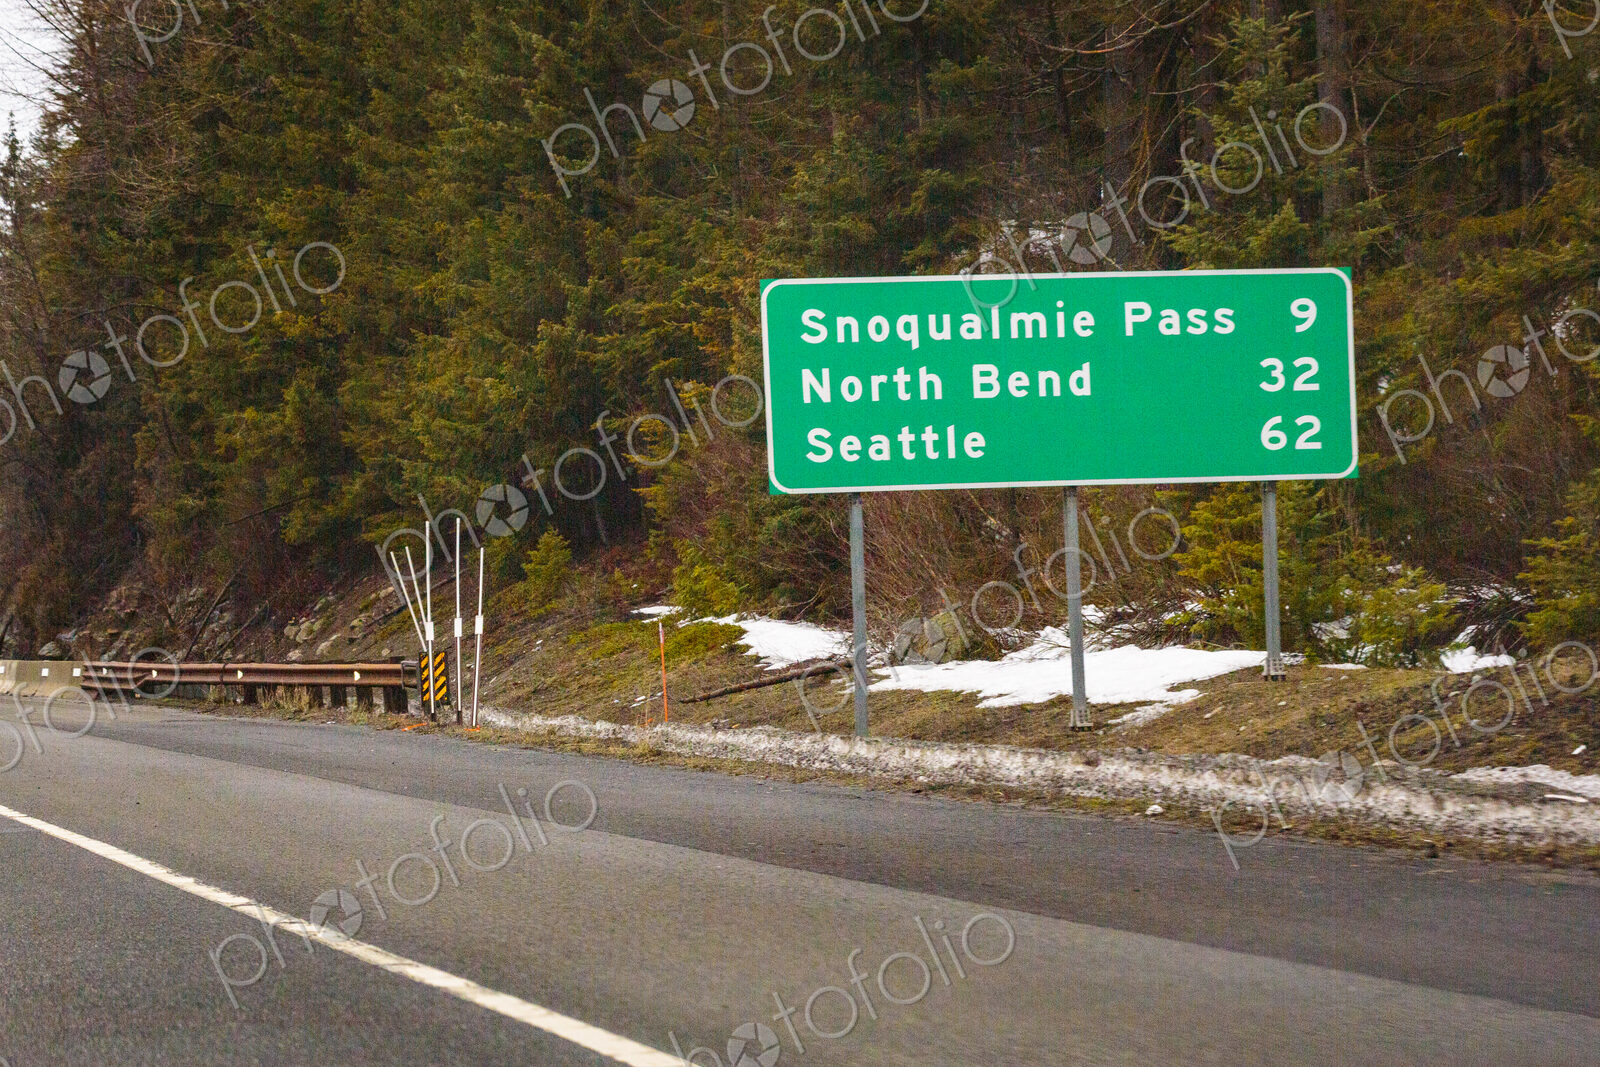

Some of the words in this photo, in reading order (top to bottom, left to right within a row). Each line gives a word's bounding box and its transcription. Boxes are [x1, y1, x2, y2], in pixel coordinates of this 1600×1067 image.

[800, 300, 1096, 351] Snoqualmie
[1123, 301, 1237, 337] Pass
[1289, 297, 1318, 334] 9
[800, 366, 943, 404] North
[971, 361, 1093, 400] Bend
[1258, 356, 1321, 393] 32
[804, 424, 987, 464] Seattle
[1259, 414, 1323, 451] 62
